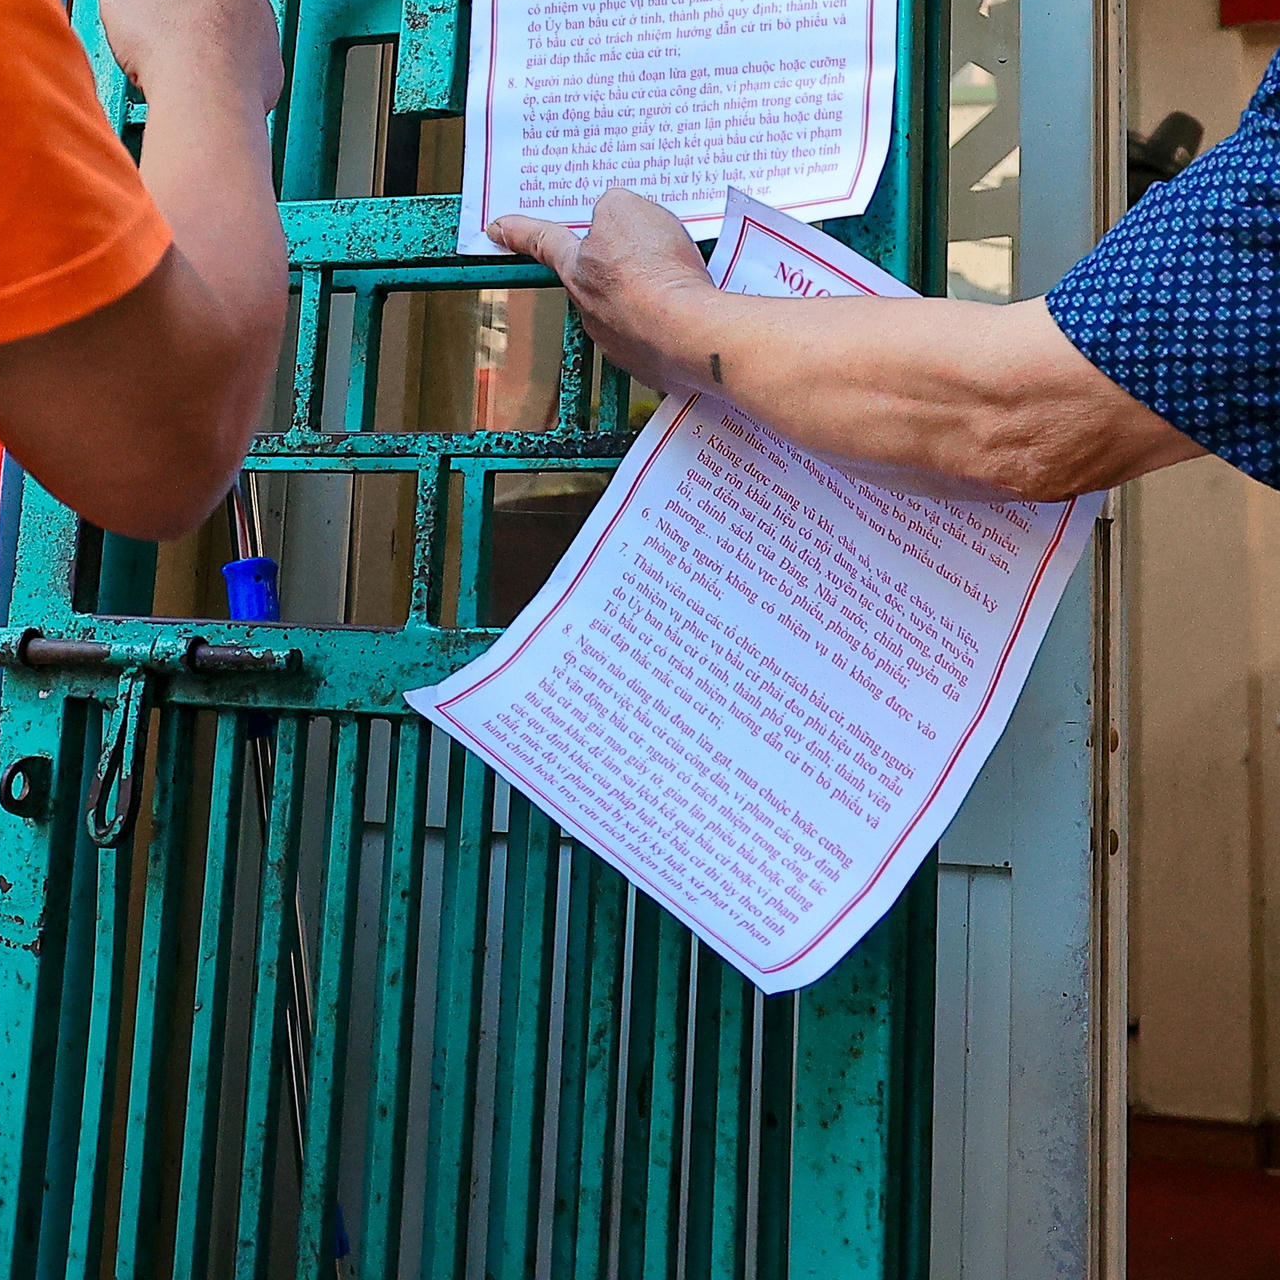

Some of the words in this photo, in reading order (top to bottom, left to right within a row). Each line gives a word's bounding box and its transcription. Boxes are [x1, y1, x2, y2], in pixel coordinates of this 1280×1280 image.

[774, 261, 813, 297] NỘI
[642, 535, 677, 566] phòng
[655, 516, 690, 552] Những
[691, 547, 725, 575] người
[724, 569, 759, 605] không
[776, 612, 811, 642] nhiệm
[831, 652, 848, 670] thì
[848, 664, 883, 701] không
[884, 695, 913, 722] được
[917, 719, 936, 740] vào
[696, 499, 726, 524] chính
[728, 522, 753, 545] sách
[813, 582, 838, 607] Nhà
[873, 631, 904, 658] chính
[905, 654, 939, 686] quyền
[942, 682, 960, 702] địa
[633, 552, 664, 585] Thành
[664, 580, 687, 602] viên
[704, 612, 724, 630] các
[734, 636, 761, 659] chức
[758, 655, 782, 676] phụ
[781, 670, 809, 697] trách
[808, 689, 830, 713] bầu
[845, 722, 882, 757] những
[880, 749, 916, 780] người
[635, 581, 667, 611] nhiệm
[680, 618, 709, 643] phục
[724, 648, 745, 671] bầu
[757, 679, 786, 702] phải
[783, 698, 805, 718] đeo
[802, 715, 827, 736] phù
[826, 729, 852, 756] hiệu
[852, 751, 878, 775] theo
[877, 765, 903, 797] mẫu
[643, 608, 663, 631] ban
[663, 620, 684, 647] bầu
[732, 681, 762, 710] thành
[759, 706, 787, 726] phố
[783, 724, 805, 744] quy
[834, 763, 865, 792] thành
[867, 788, 891, 813] viên
